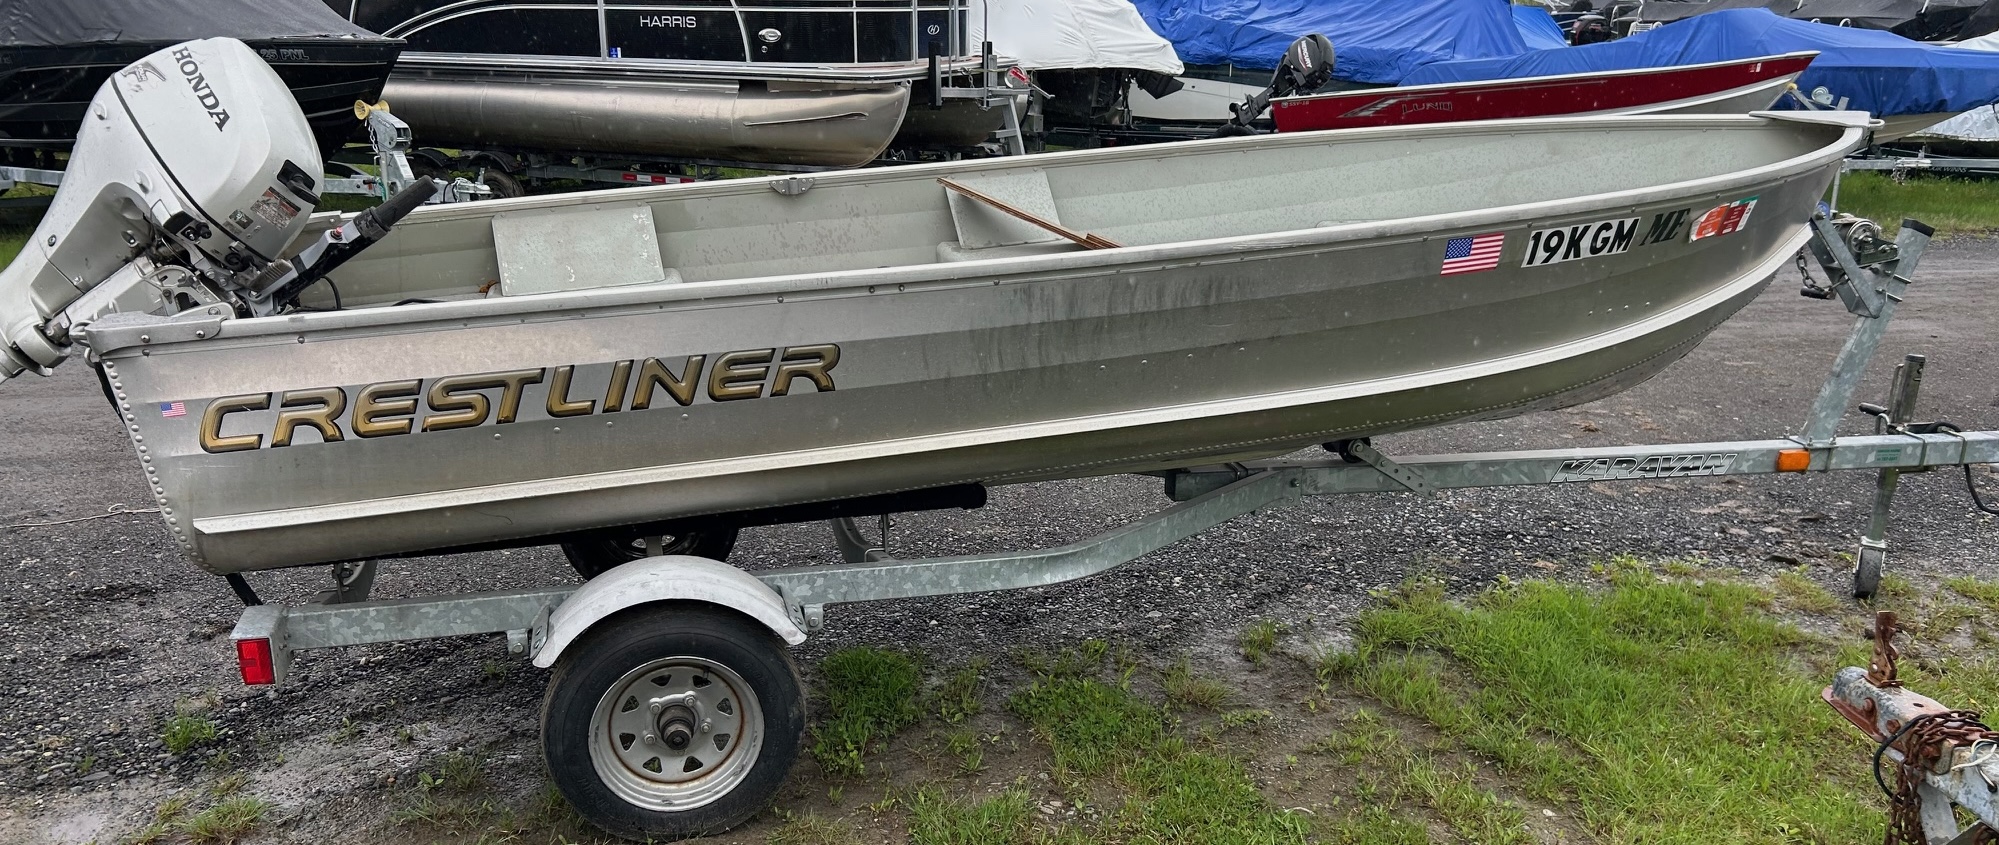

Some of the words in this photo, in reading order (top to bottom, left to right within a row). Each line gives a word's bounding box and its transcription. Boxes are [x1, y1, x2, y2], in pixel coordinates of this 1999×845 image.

[639, 15, 697, 28] HARRIS
[280, 48, 310, 61] PNL
[1301, 40, 1313, 69] MERCURY
[172, 46, 231, 132] HONDA
[1402, 101, 1453, 115] LUND
[1638, 207, 1692, 246] ME
[199, 342, 842, 455] CRESTLINER
[1550, 453, 1738, 483] KARAVAN
